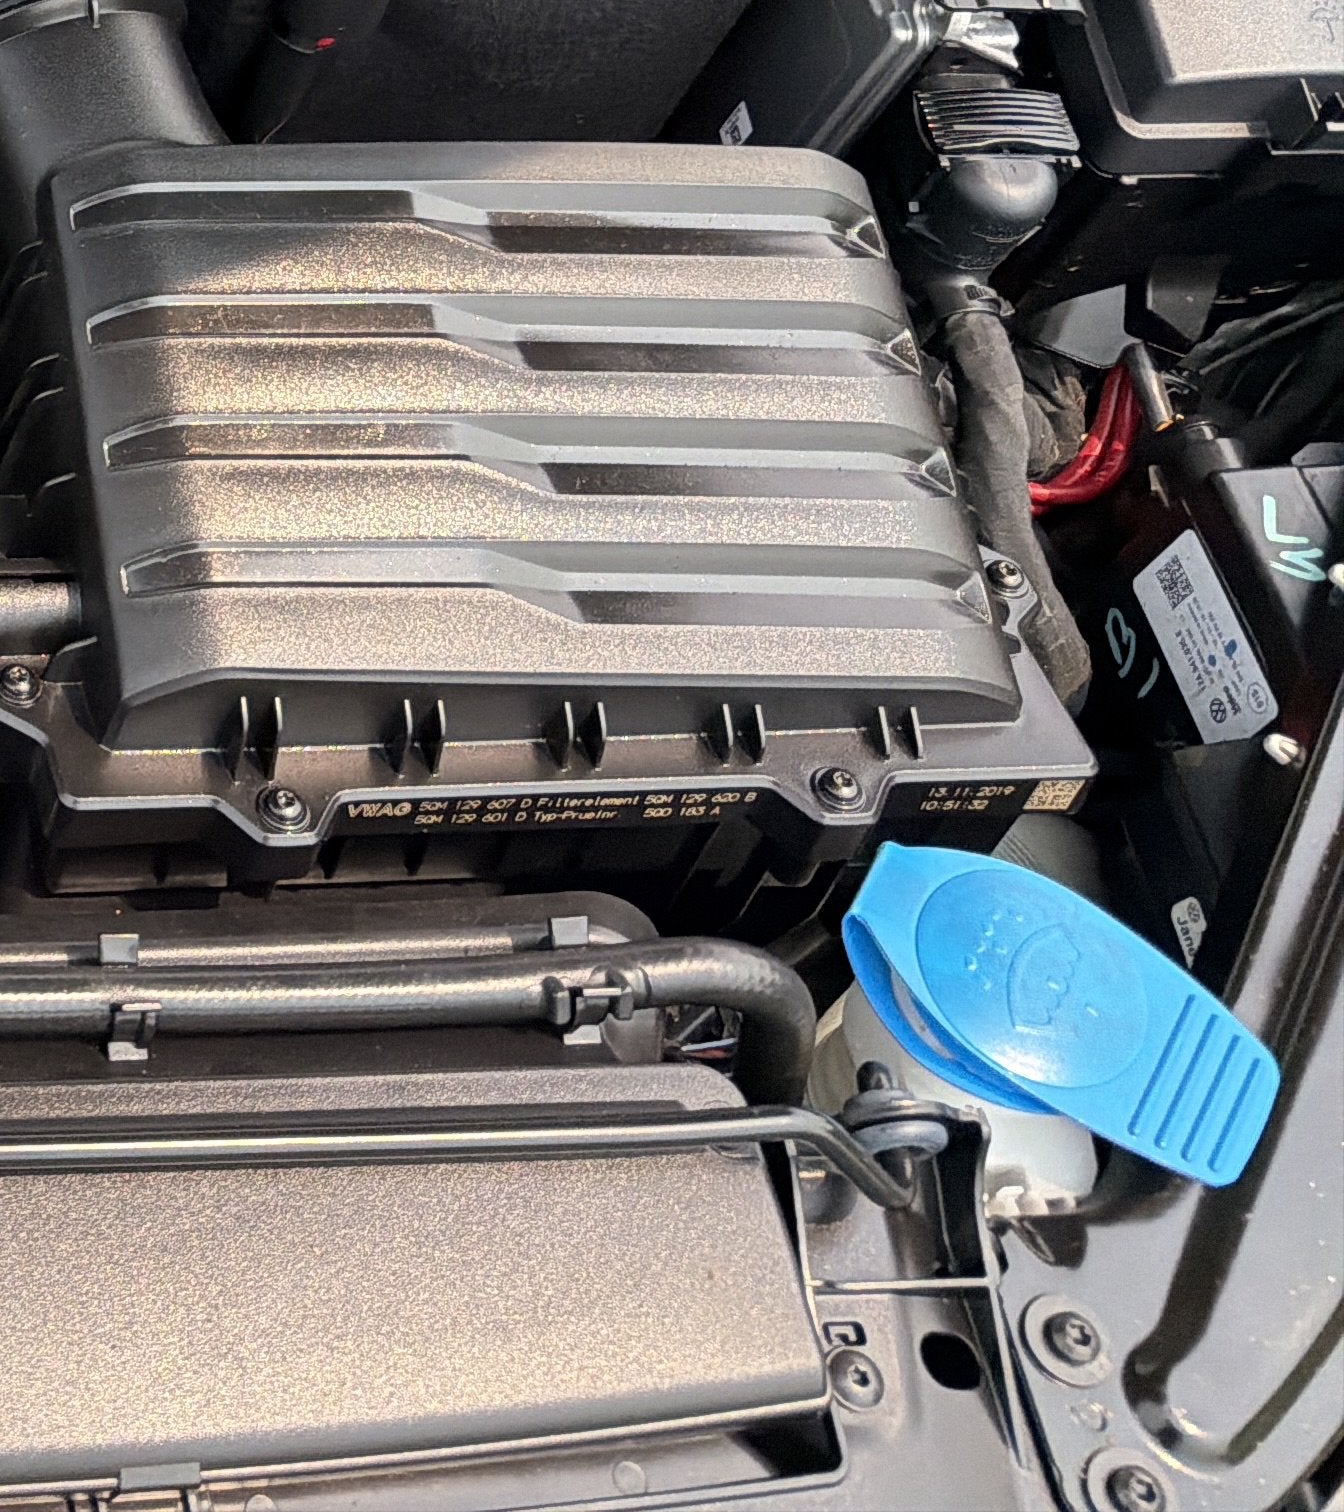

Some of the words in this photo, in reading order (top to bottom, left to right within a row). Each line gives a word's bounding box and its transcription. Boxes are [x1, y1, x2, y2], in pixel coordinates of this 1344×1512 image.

[928, 786, 1016, 798] 13.11.2019
[455, 799, 482, 810] 129
[486, 798, 515, 810] 607
[519, 798, 533, 808] D
[536, 795, 639, 808] Filterelement
[680, 792, 707, 804] 129
[711, 792, 741, 803] 620
[743, 791, 758, 803] B
[920, 799, 990, 810] 10:51:32
[451, 813, 477, 823] 129
[481, 812, 509, 822] 601
[515, 811, 527, 822] D
[679, 806, 706, 817] 183
[709, 805, 721, 815] A
